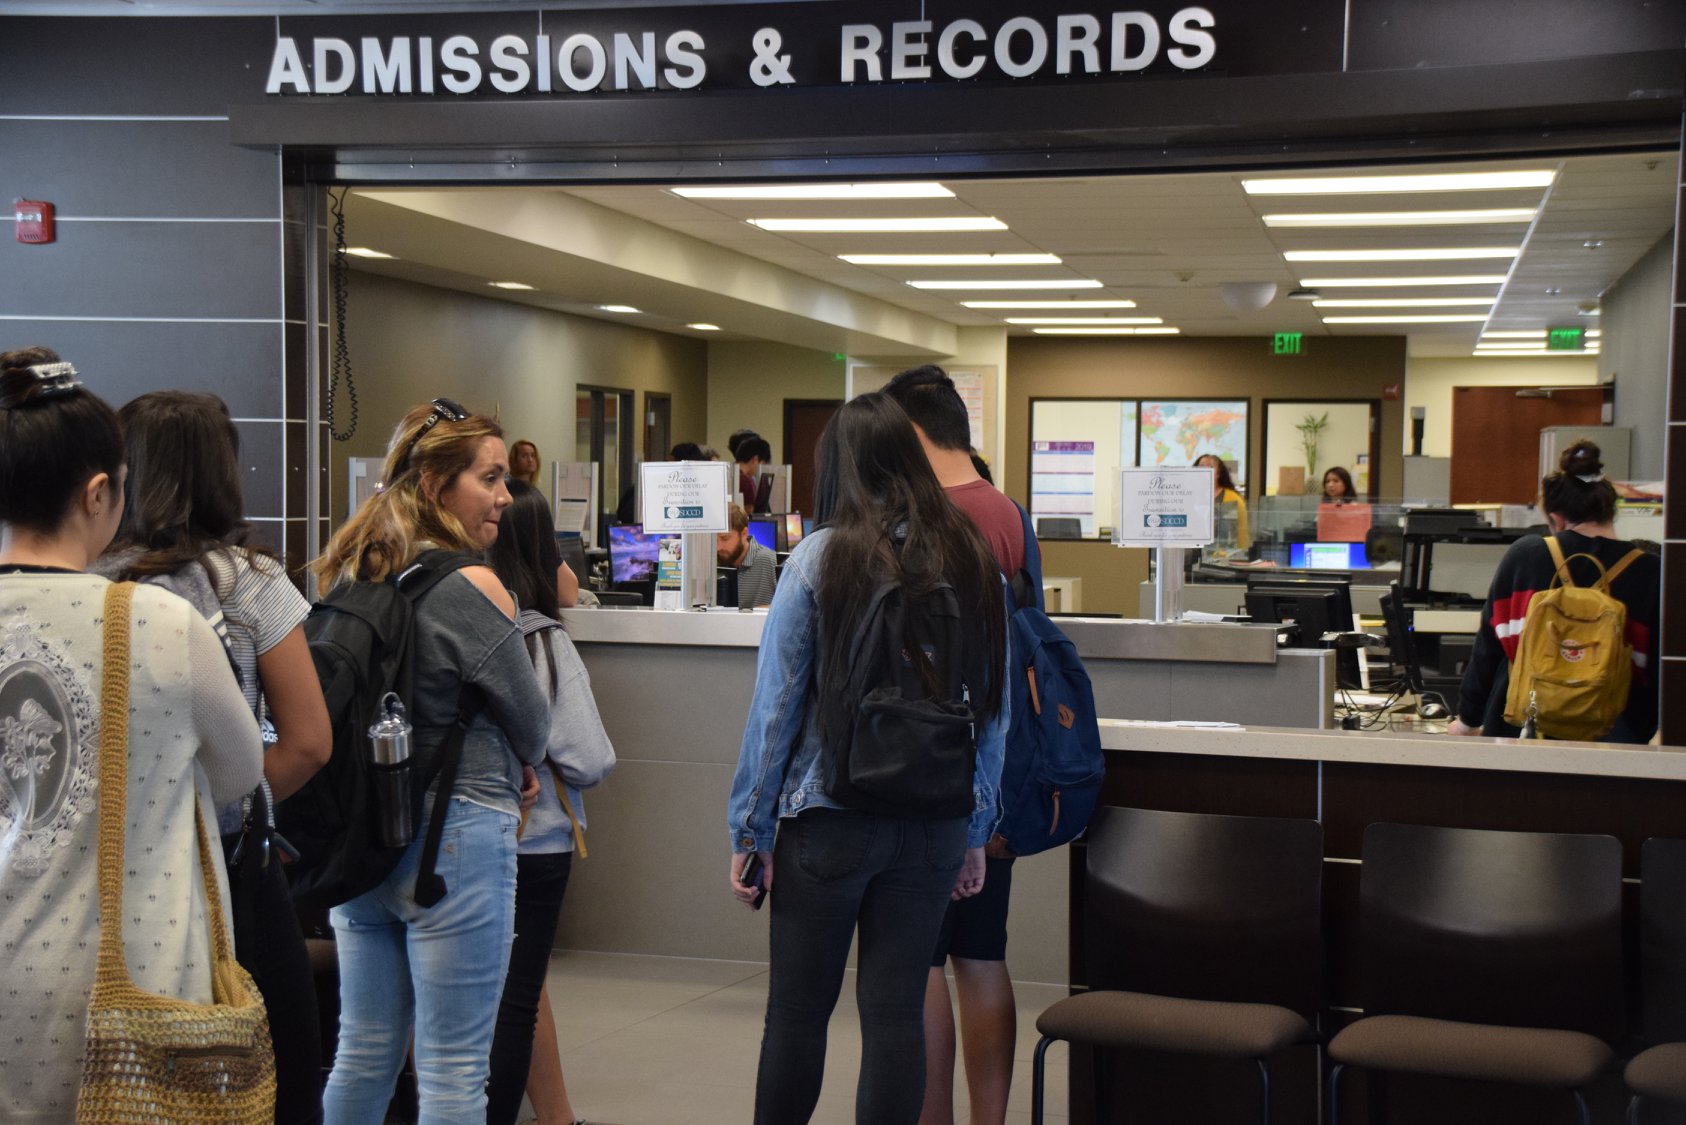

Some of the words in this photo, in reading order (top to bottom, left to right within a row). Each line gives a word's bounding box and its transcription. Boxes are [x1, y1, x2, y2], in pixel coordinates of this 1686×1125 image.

[266, 30, 706, 94] ADMISSIONS
[749, 27, 796, 87] &
[841, 7, 1216, 82] RECORDS
[1275, 333, 1302, 354] EXIT
[1551, 329, 1580, 350] EXIT
[668, 471, 697, 483] Please
[1149, 477, 1181, 490] Please
